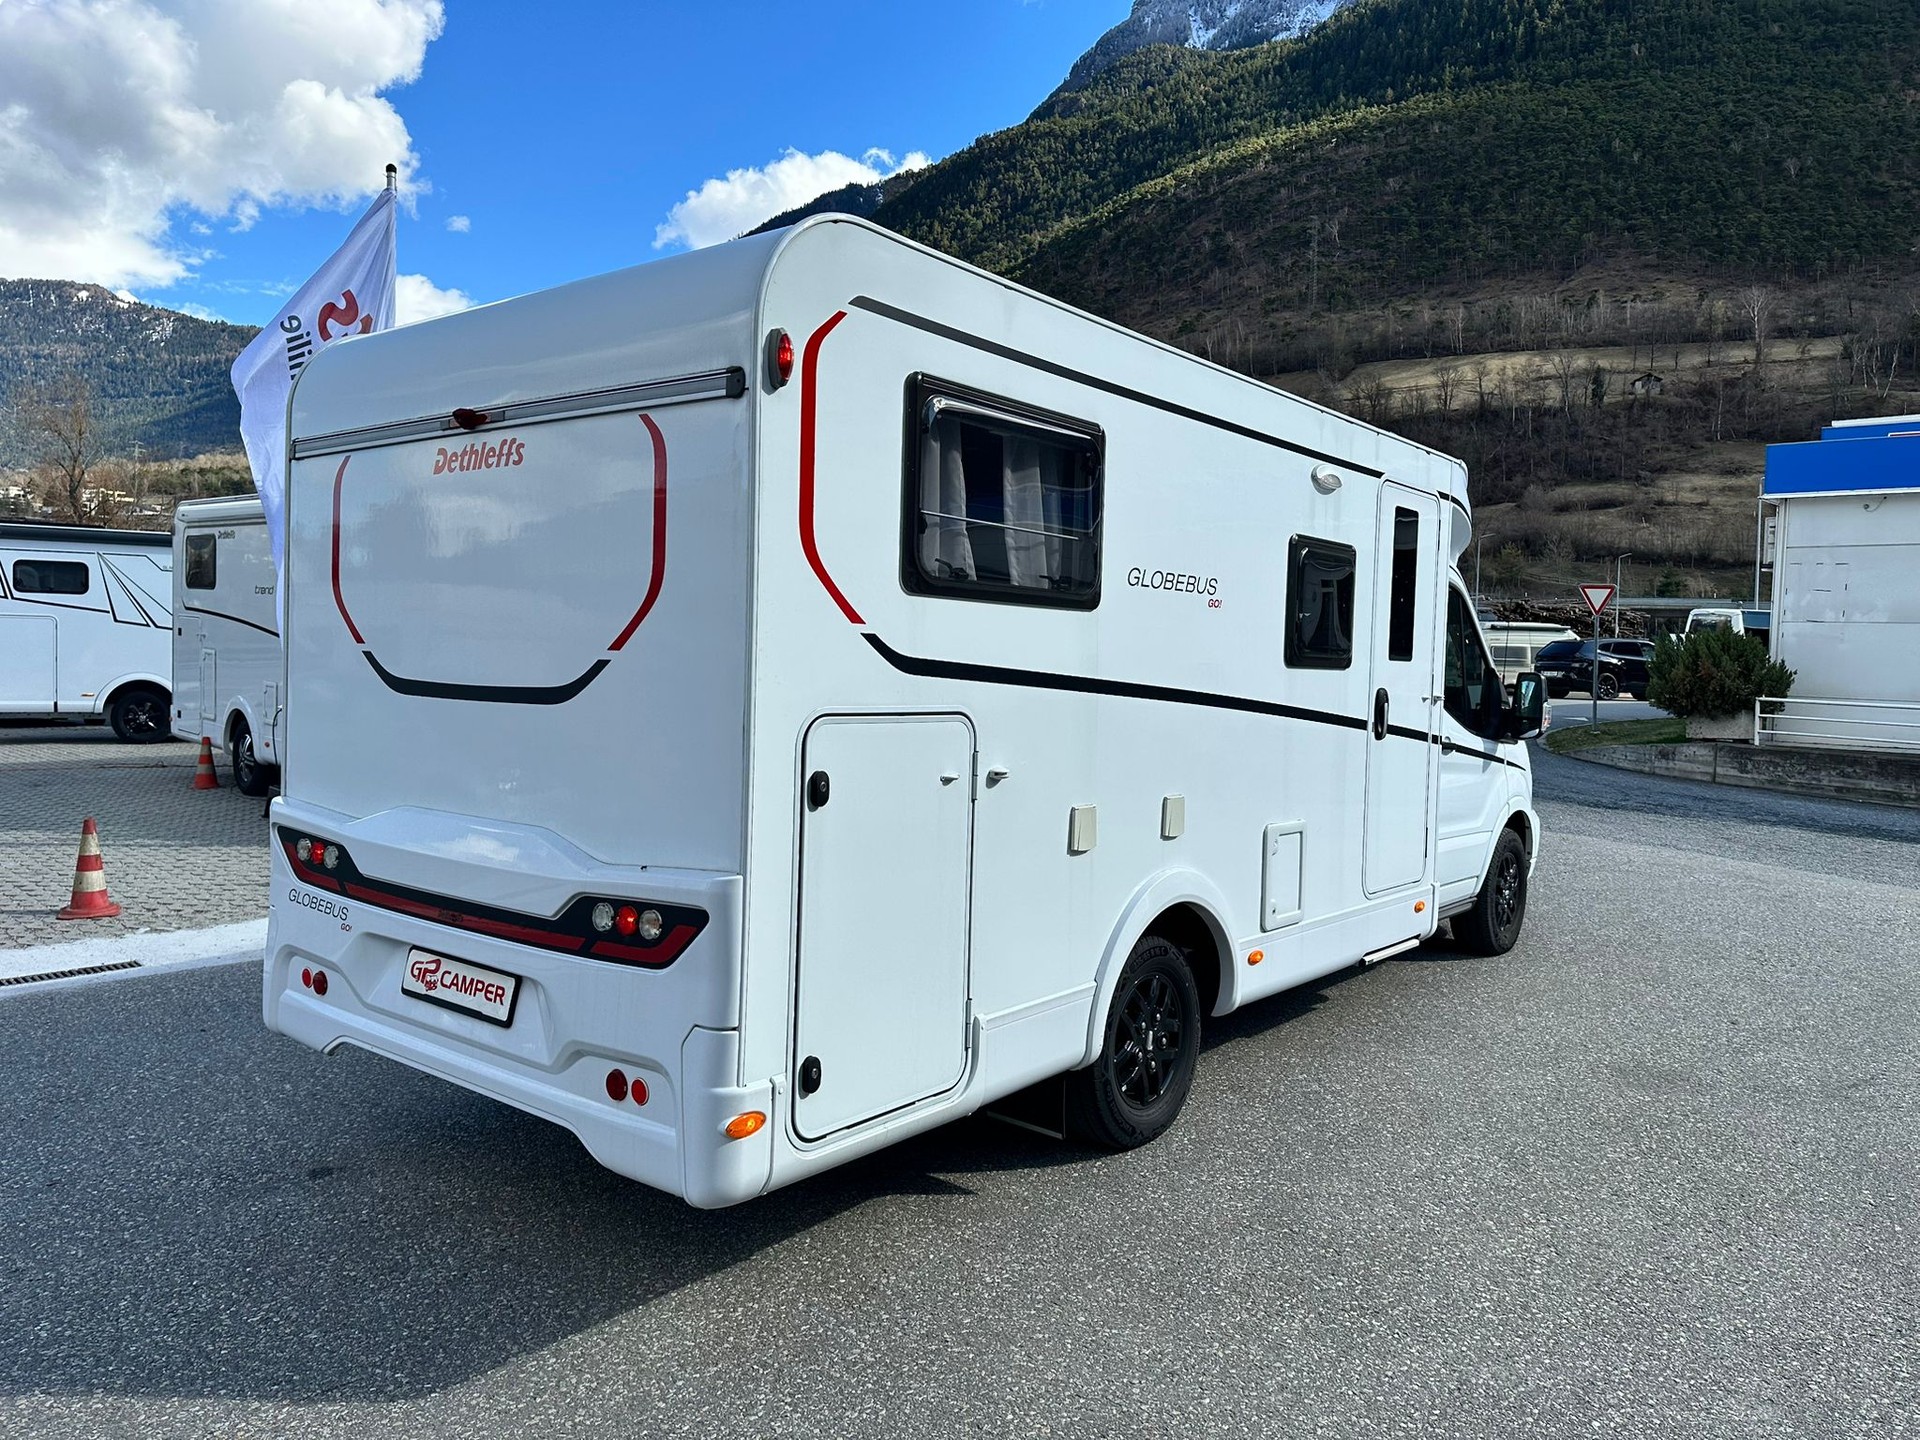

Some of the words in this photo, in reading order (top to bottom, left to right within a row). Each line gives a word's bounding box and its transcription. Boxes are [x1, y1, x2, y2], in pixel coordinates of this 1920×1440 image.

[433, 437, 525, 475] Dethleffs
[254, 585, 275, 595] trend
[1127, 567, 1218, 595] GLOBEBUS
[1207, 598, 1222, 608] GO!
[288, 888, 349, 921] GLOBEBUS
[340, 923, 352, 932] GO!
[440, 970, 505, 1006] CAMPER
